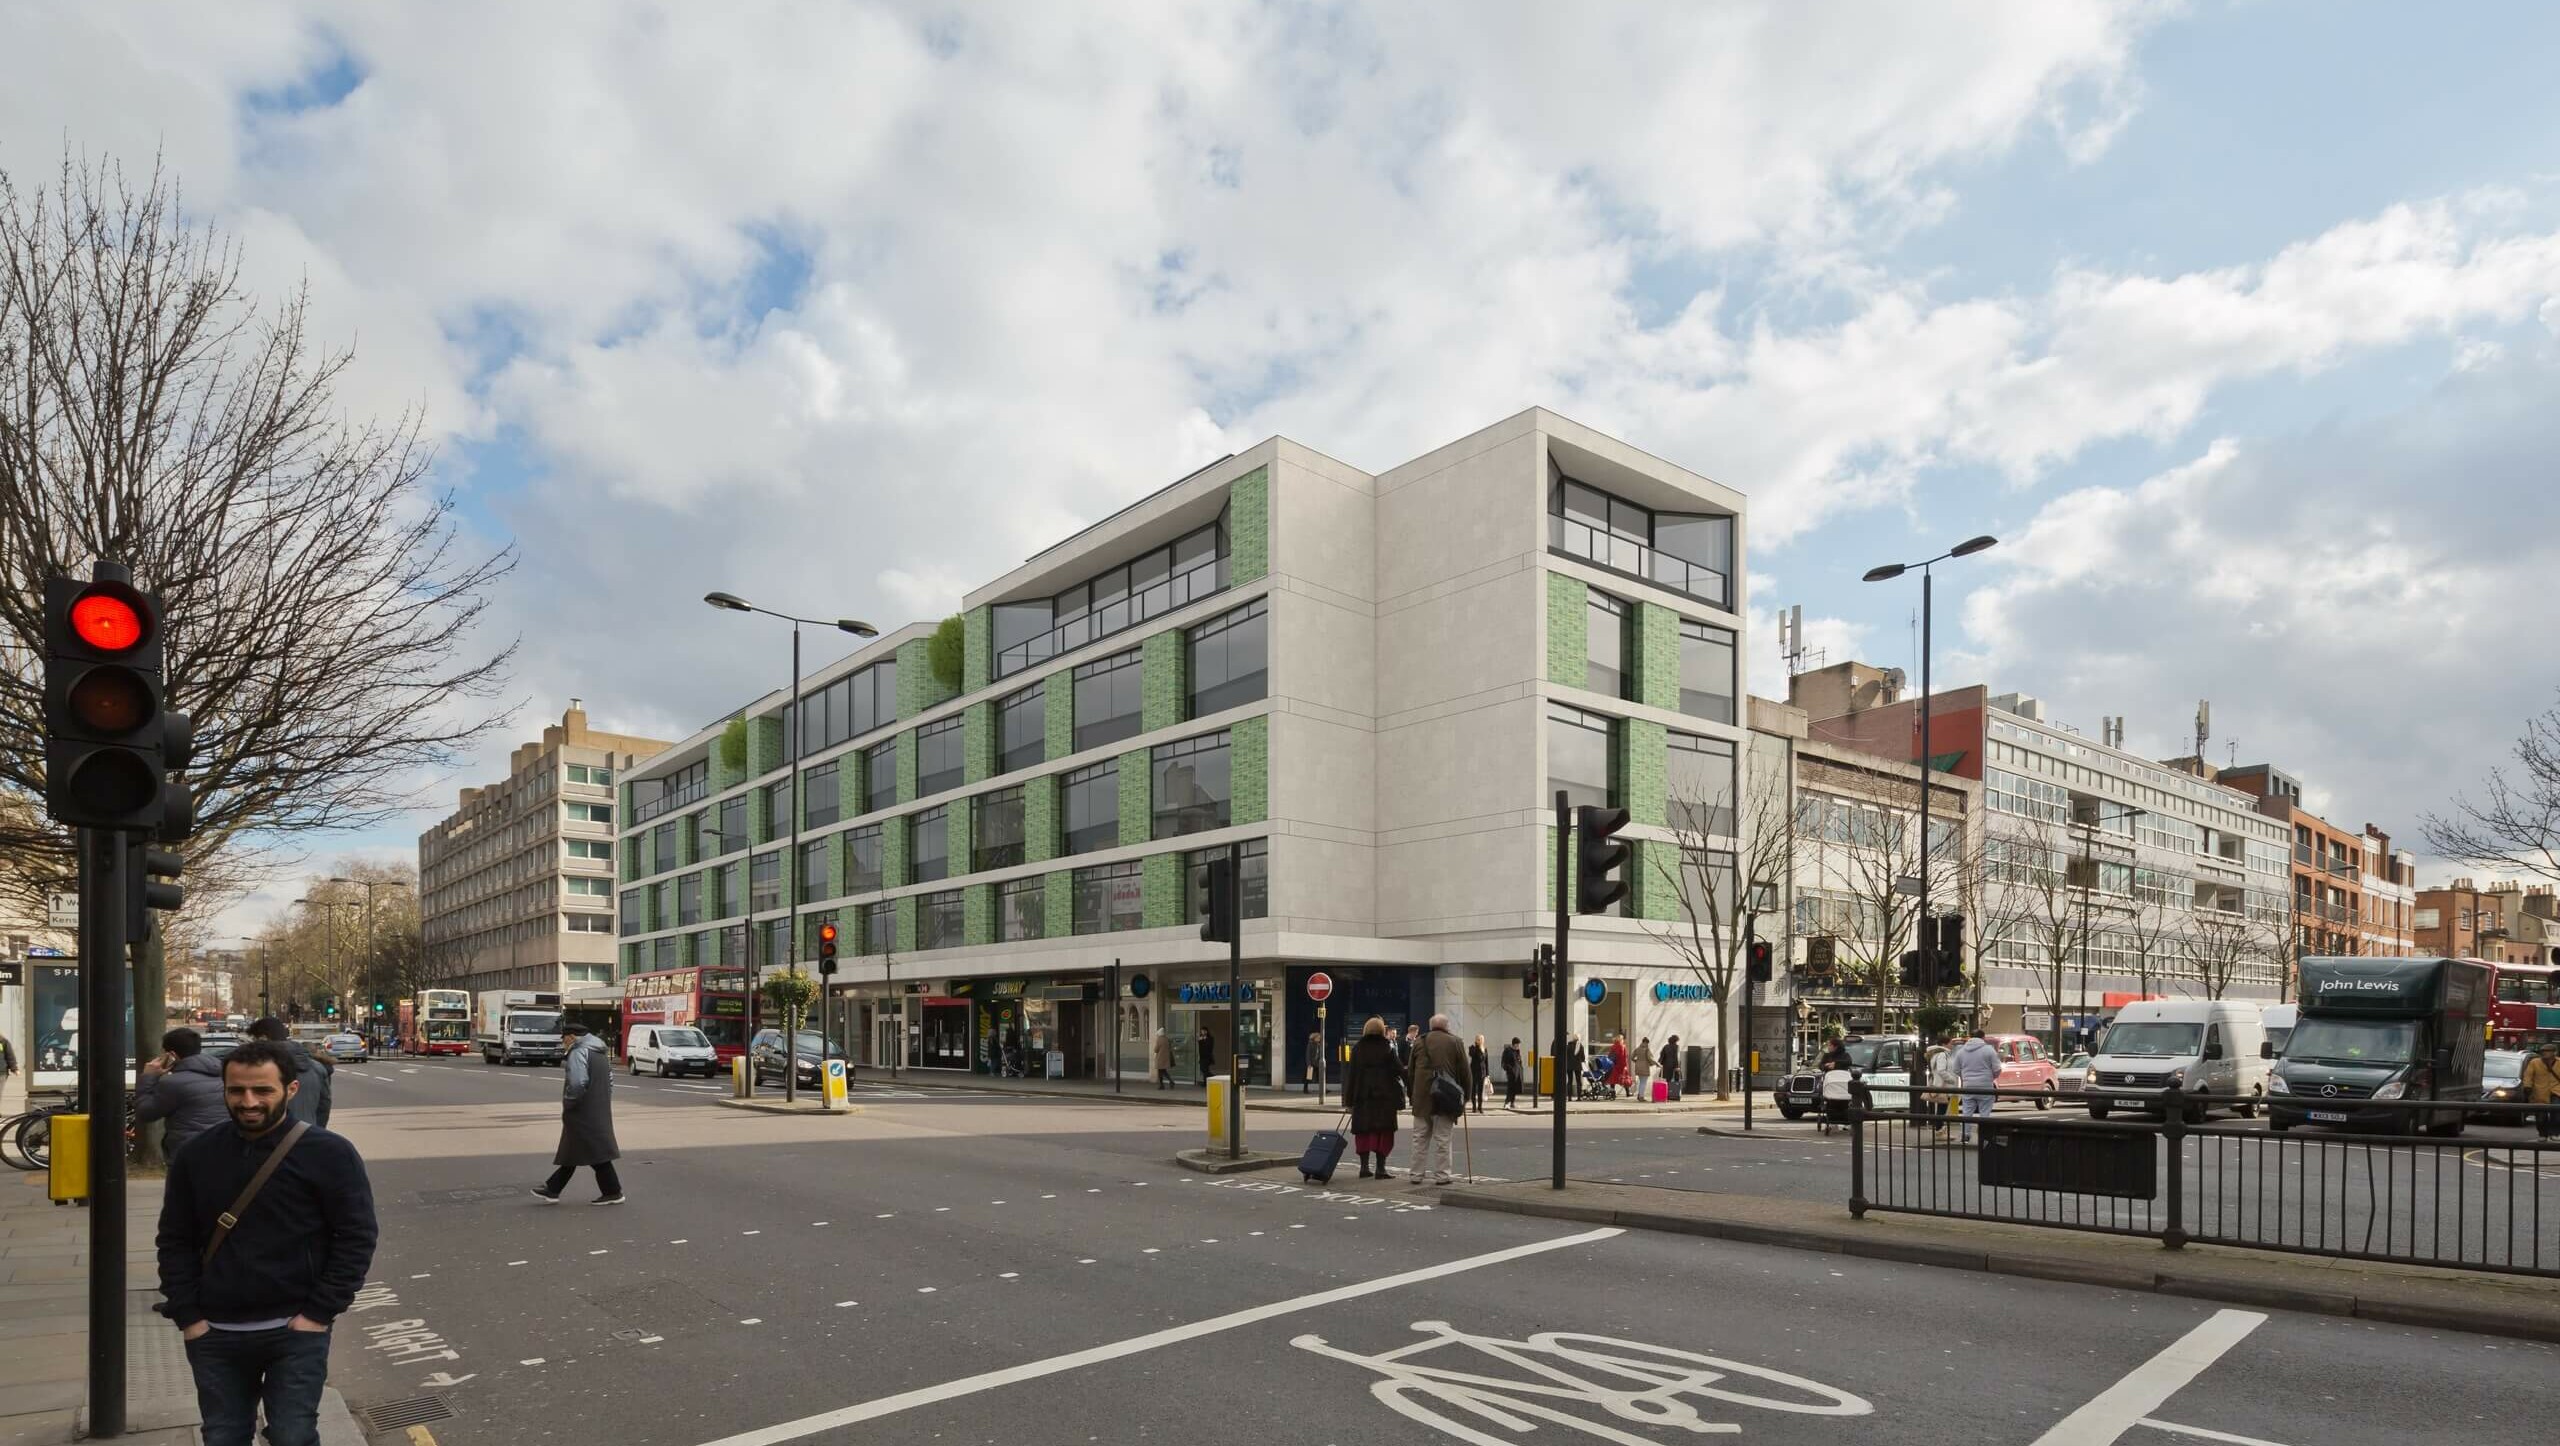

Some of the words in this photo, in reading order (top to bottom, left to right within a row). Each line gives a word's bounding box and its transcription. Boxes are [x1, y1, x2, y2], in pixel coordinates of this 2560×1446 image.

[992, 981, 1026, 995] SUBWAY
[1191, 981, 1255, 1000] BARCLYS
[1669, 984, 1714, 999] BARCLA
[2318, 979, 2353, 993] John
[2356, 979, 2400, 991] Lewis
[1204, 1178, 1305, 1195] LEFT
[361, 1318, 461, 1366] RIGHT
